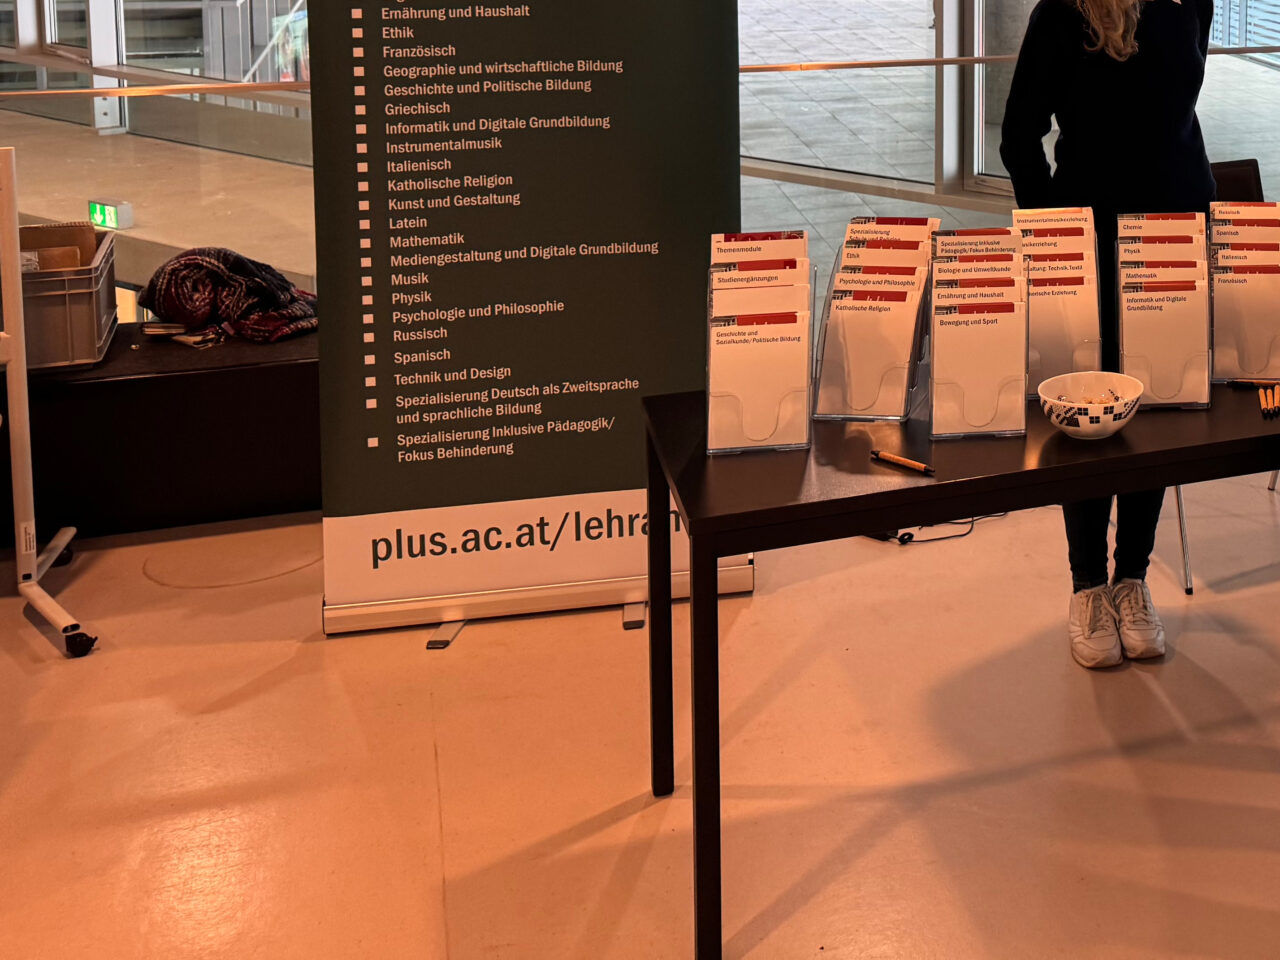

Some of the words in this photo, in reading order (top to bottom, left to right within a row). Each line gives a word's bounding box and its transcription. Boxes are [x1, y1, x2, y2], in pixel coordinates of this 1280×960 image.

[381, 7, 445, 21] Ernährung
[449, 6, 472, 18] und
[475, 5, 530, 17] Haushalt
[382, 27, 414, 38] Ethik
[383, 45, 456, 58] Französisch
[384, 64, 456, 79] Geographie
[459, 63, 482, 74] und
[485, 61, 574, 74] wirtschaftliche
[577, 60, 623, 73] Bildung
[384, 83, 453, 96] Geschichte
[457, 82, 480, 93] und
[483, 80, 542, 92] Politische
[546, 79, 592, 92] Bildung
[385, 102, 450, 115] Griechisch
[386, 121, 450, 135] Informatik
[453, 120, 476, 132] und
[479, 118, 526, 132] Digitale
[529, 116, 610, 129] Grundbildung
[386, 137, 502, 154] Instrumentalmusik
[387, 159, 451, 173] Italienisch
[388, 177, 460, 192] Katholische
[464, 175, 513, 188] Religion
[388, 198, 424, 211] Kunst
[427, 196, 450, 208] und
[453, 193, 520, 207] Gestaltung
[389, 217, 427, 229] Latein
[390, 233, 464, 248] Mathematik
[390, 249, 501, 268] Mediengestaltung
[504, 247, 527, 259] und
[530, 245, 576, 259] Digitale
[579, 242, 659, 256] Grundbildung
[717, 246, 761, 254] Themenmodule
[391, 273, 428, 286] Musik
[718, 275, 778, 283] Studienergänzungen
[839, 278, 870, 287] Psychologie
[392, 292, 432, 306] Physik
[393, 307, 466, 325] Psychologie
[468, 304, 491, 317] und
[495, 300, 564, 315] Philosophie
[393, 328, 447, 342] Russisch
[394, 349, 450, 364] Spanisch
[394, 372, 441, 386] Technik
[444, 370, 467, 382] und
[470, 366, 511, 380] Design
[396, 390, 488, 407] Spezialisierung
[491, 385, 539, 400] Deutsch
[543, 383, 559, 395] als
[562, 378, 639, 394] Zweitsprache
[397, 412, 419, 424] und
[423, 406, 493, 423] sprachliche
[496, 402, 541, 416] Bildung
[397, 428, 489, 446] Spezialisierung
[492, 423, 544, 438] Inklusive
[547, 417, 615, 433] Pädagogik/
[398, 449, 434, 463] Fokus
[437, 443, 514, 459] Behinderung
